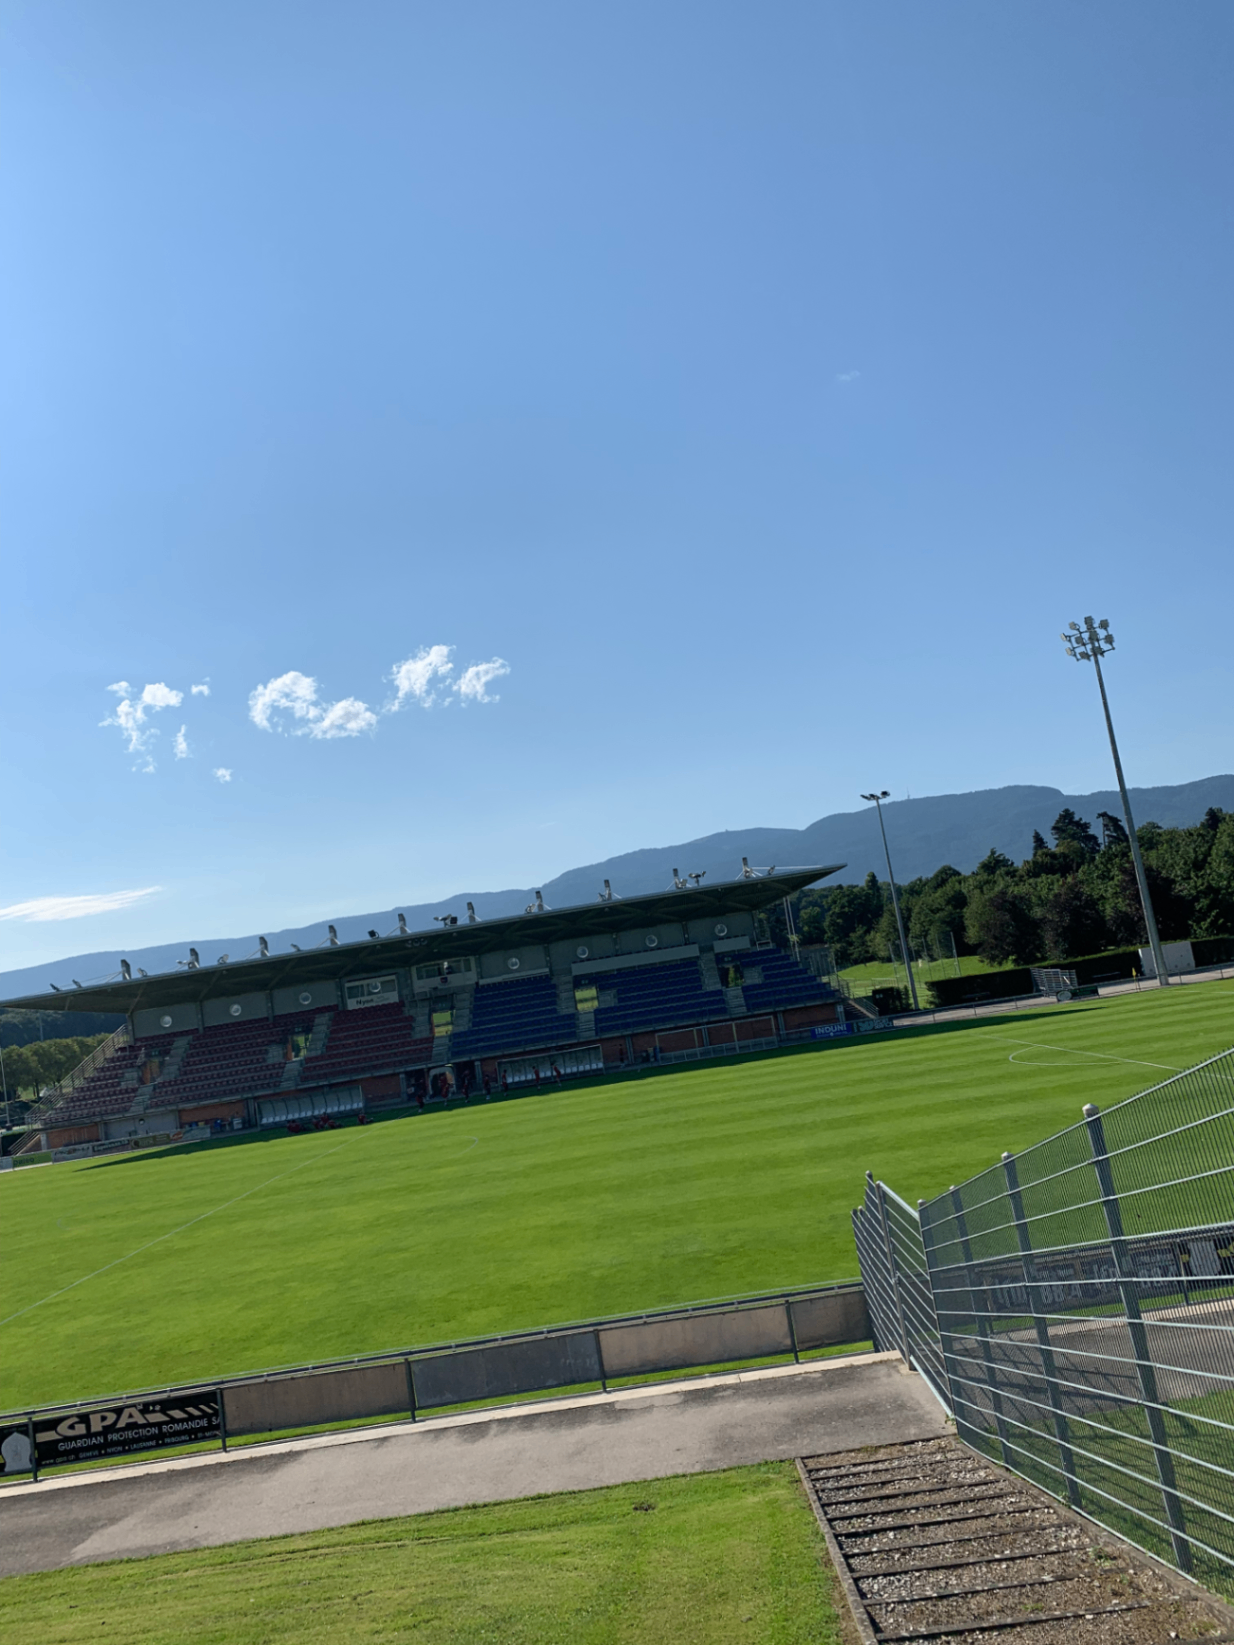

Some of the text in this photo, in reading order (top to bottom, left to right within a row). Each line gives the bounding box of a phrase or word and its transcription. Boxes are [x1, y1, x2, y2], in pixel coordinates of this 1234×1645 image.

[814, 1023, 847, 1035] INDUNI
[56, 1406, 145, 1437] GPA
[57, 1435, 104, 1451] GUARDIAN
[107, 1426, 159, 1442] PROTECTION
[162, 1417, 208, 1433] ROMANDIE
